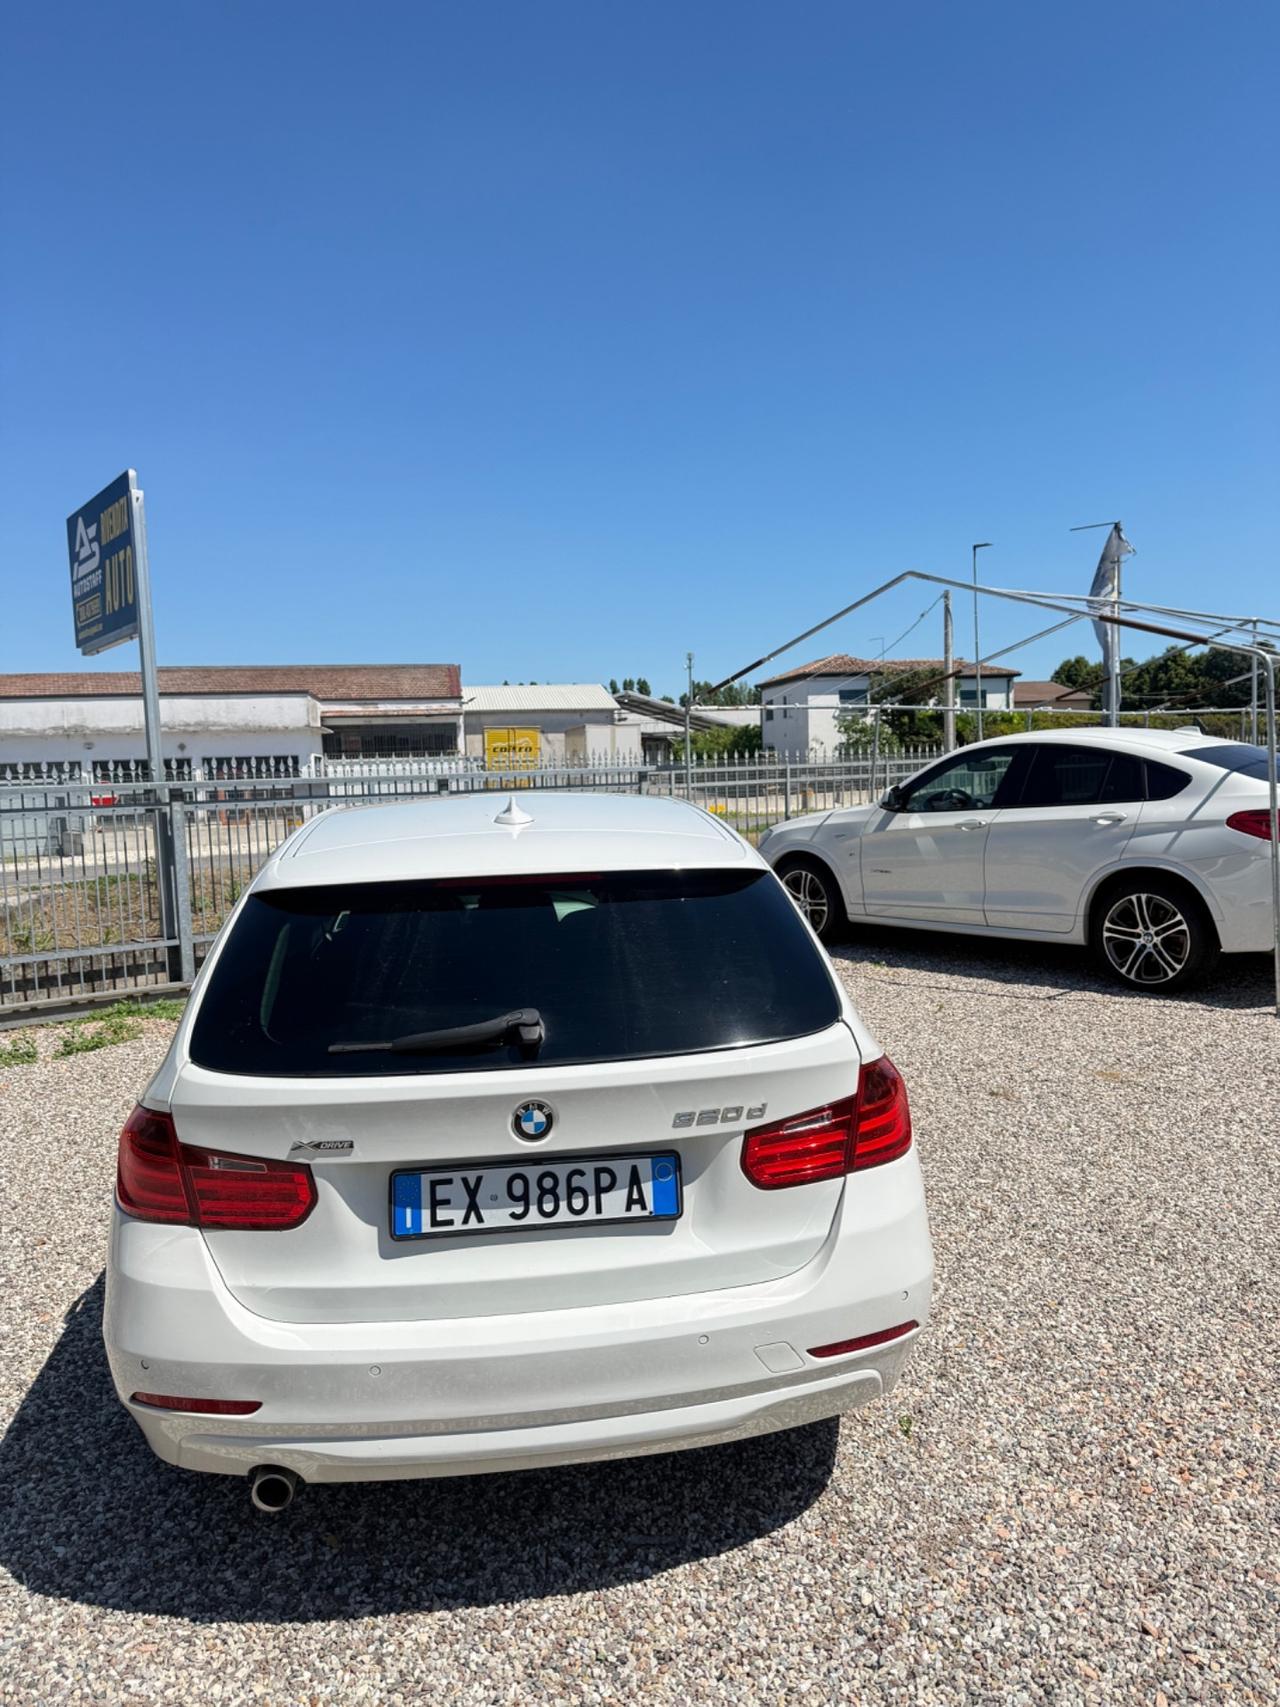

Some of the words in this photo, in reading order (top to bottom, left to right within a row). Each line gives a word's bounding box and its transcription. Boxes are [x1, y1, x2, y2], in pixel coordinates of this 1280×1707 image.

[105, 545, 134, 616] AUTO
[429, 1175, 485, 1228] EX
[506, 1164, 649, 1221] 986PA
